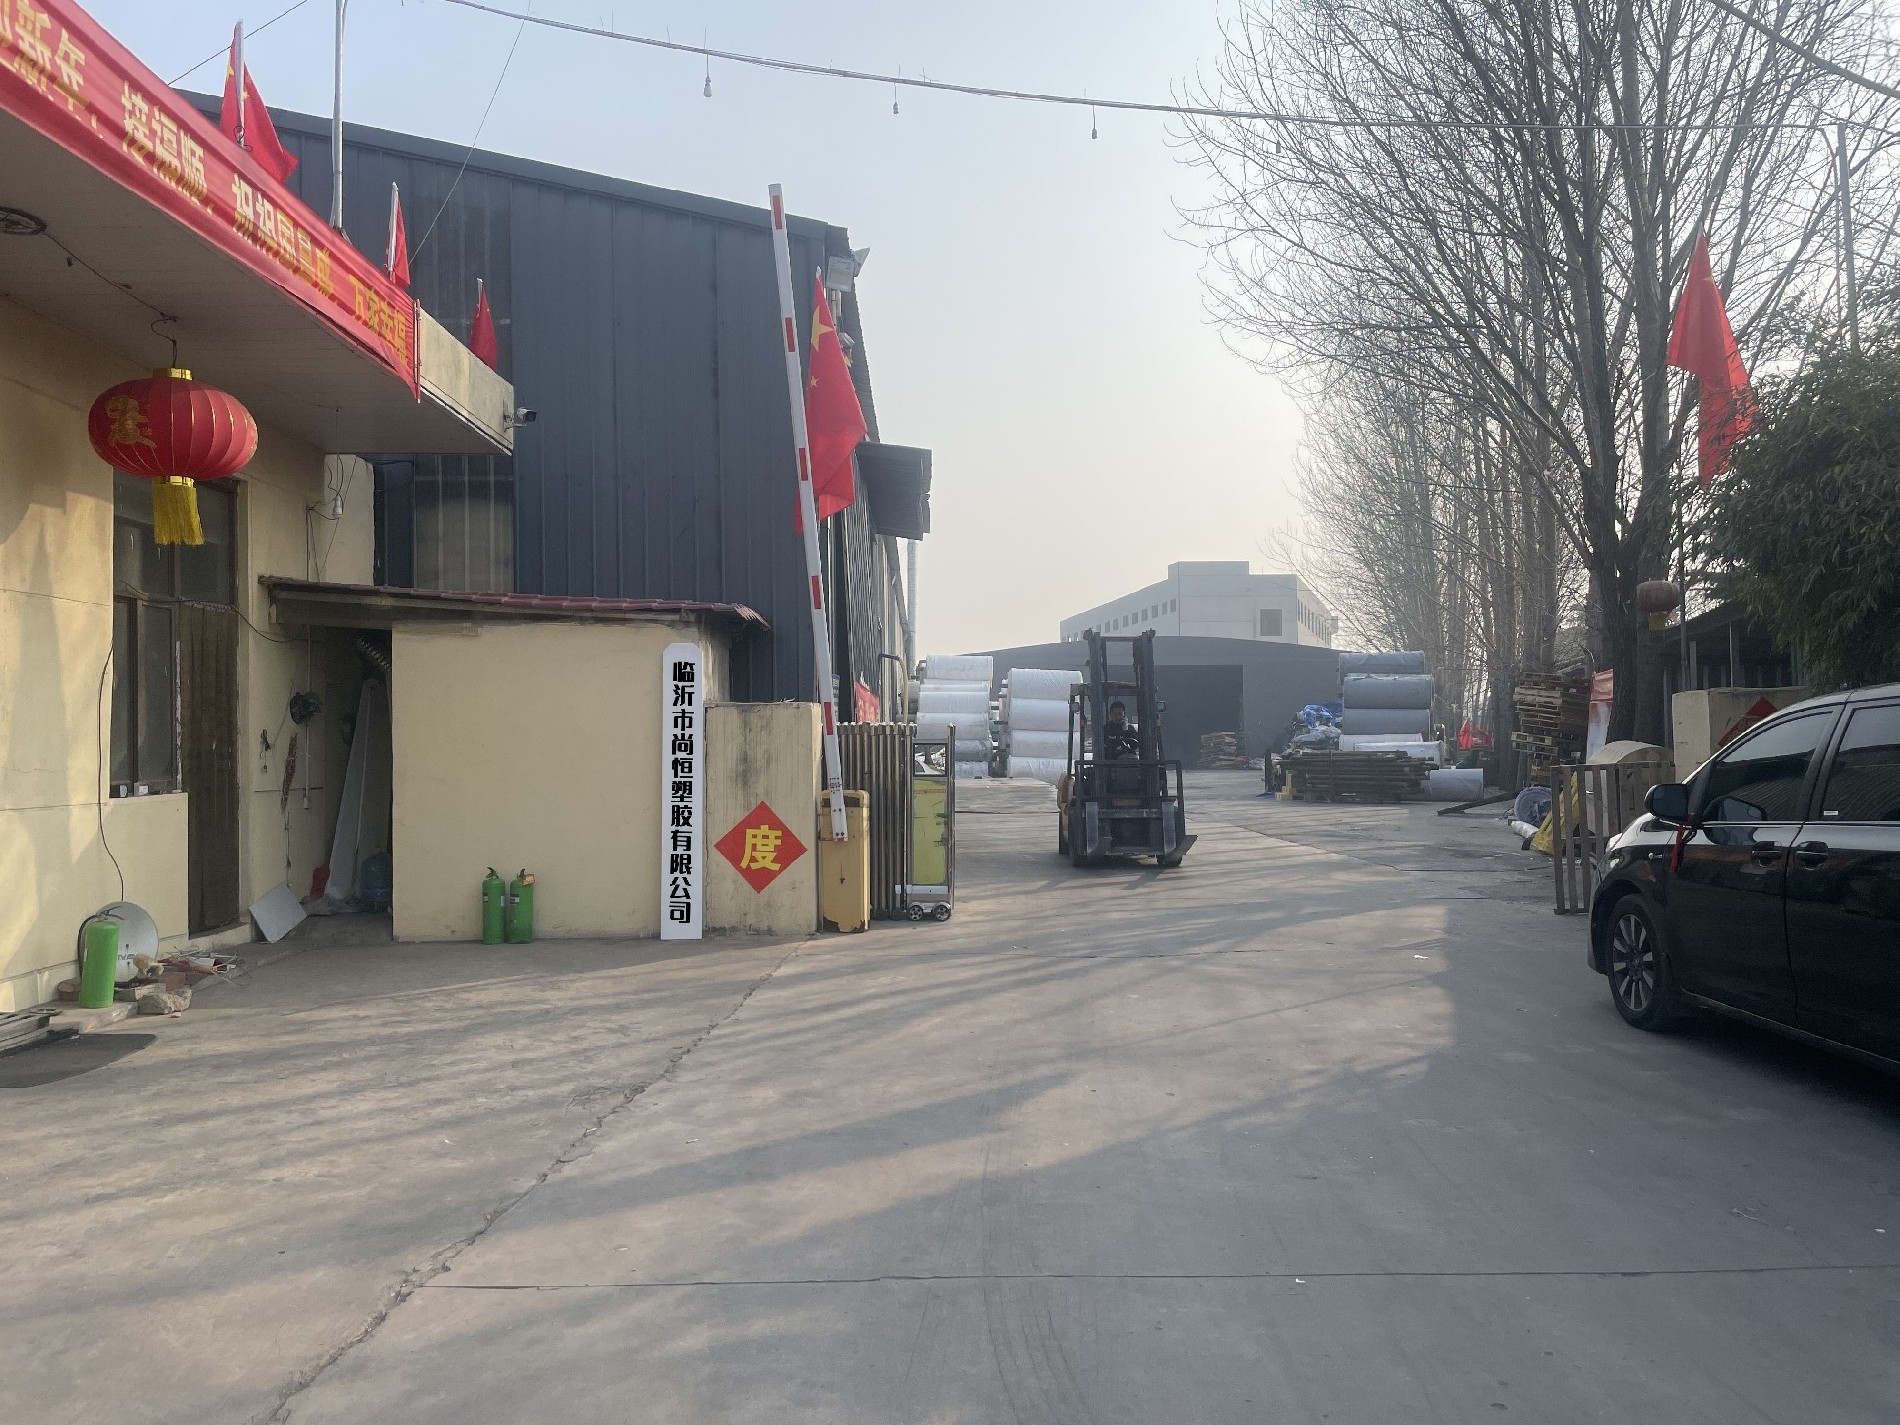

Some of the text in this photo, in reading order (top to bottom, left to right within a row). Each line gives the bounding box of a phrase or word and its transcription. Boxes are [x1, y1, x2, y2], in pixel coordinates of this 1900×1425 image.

[669, 661, 695, 923] 临沂市尚恒塑胶有限公司
[740, 825, 783, 870] 度
